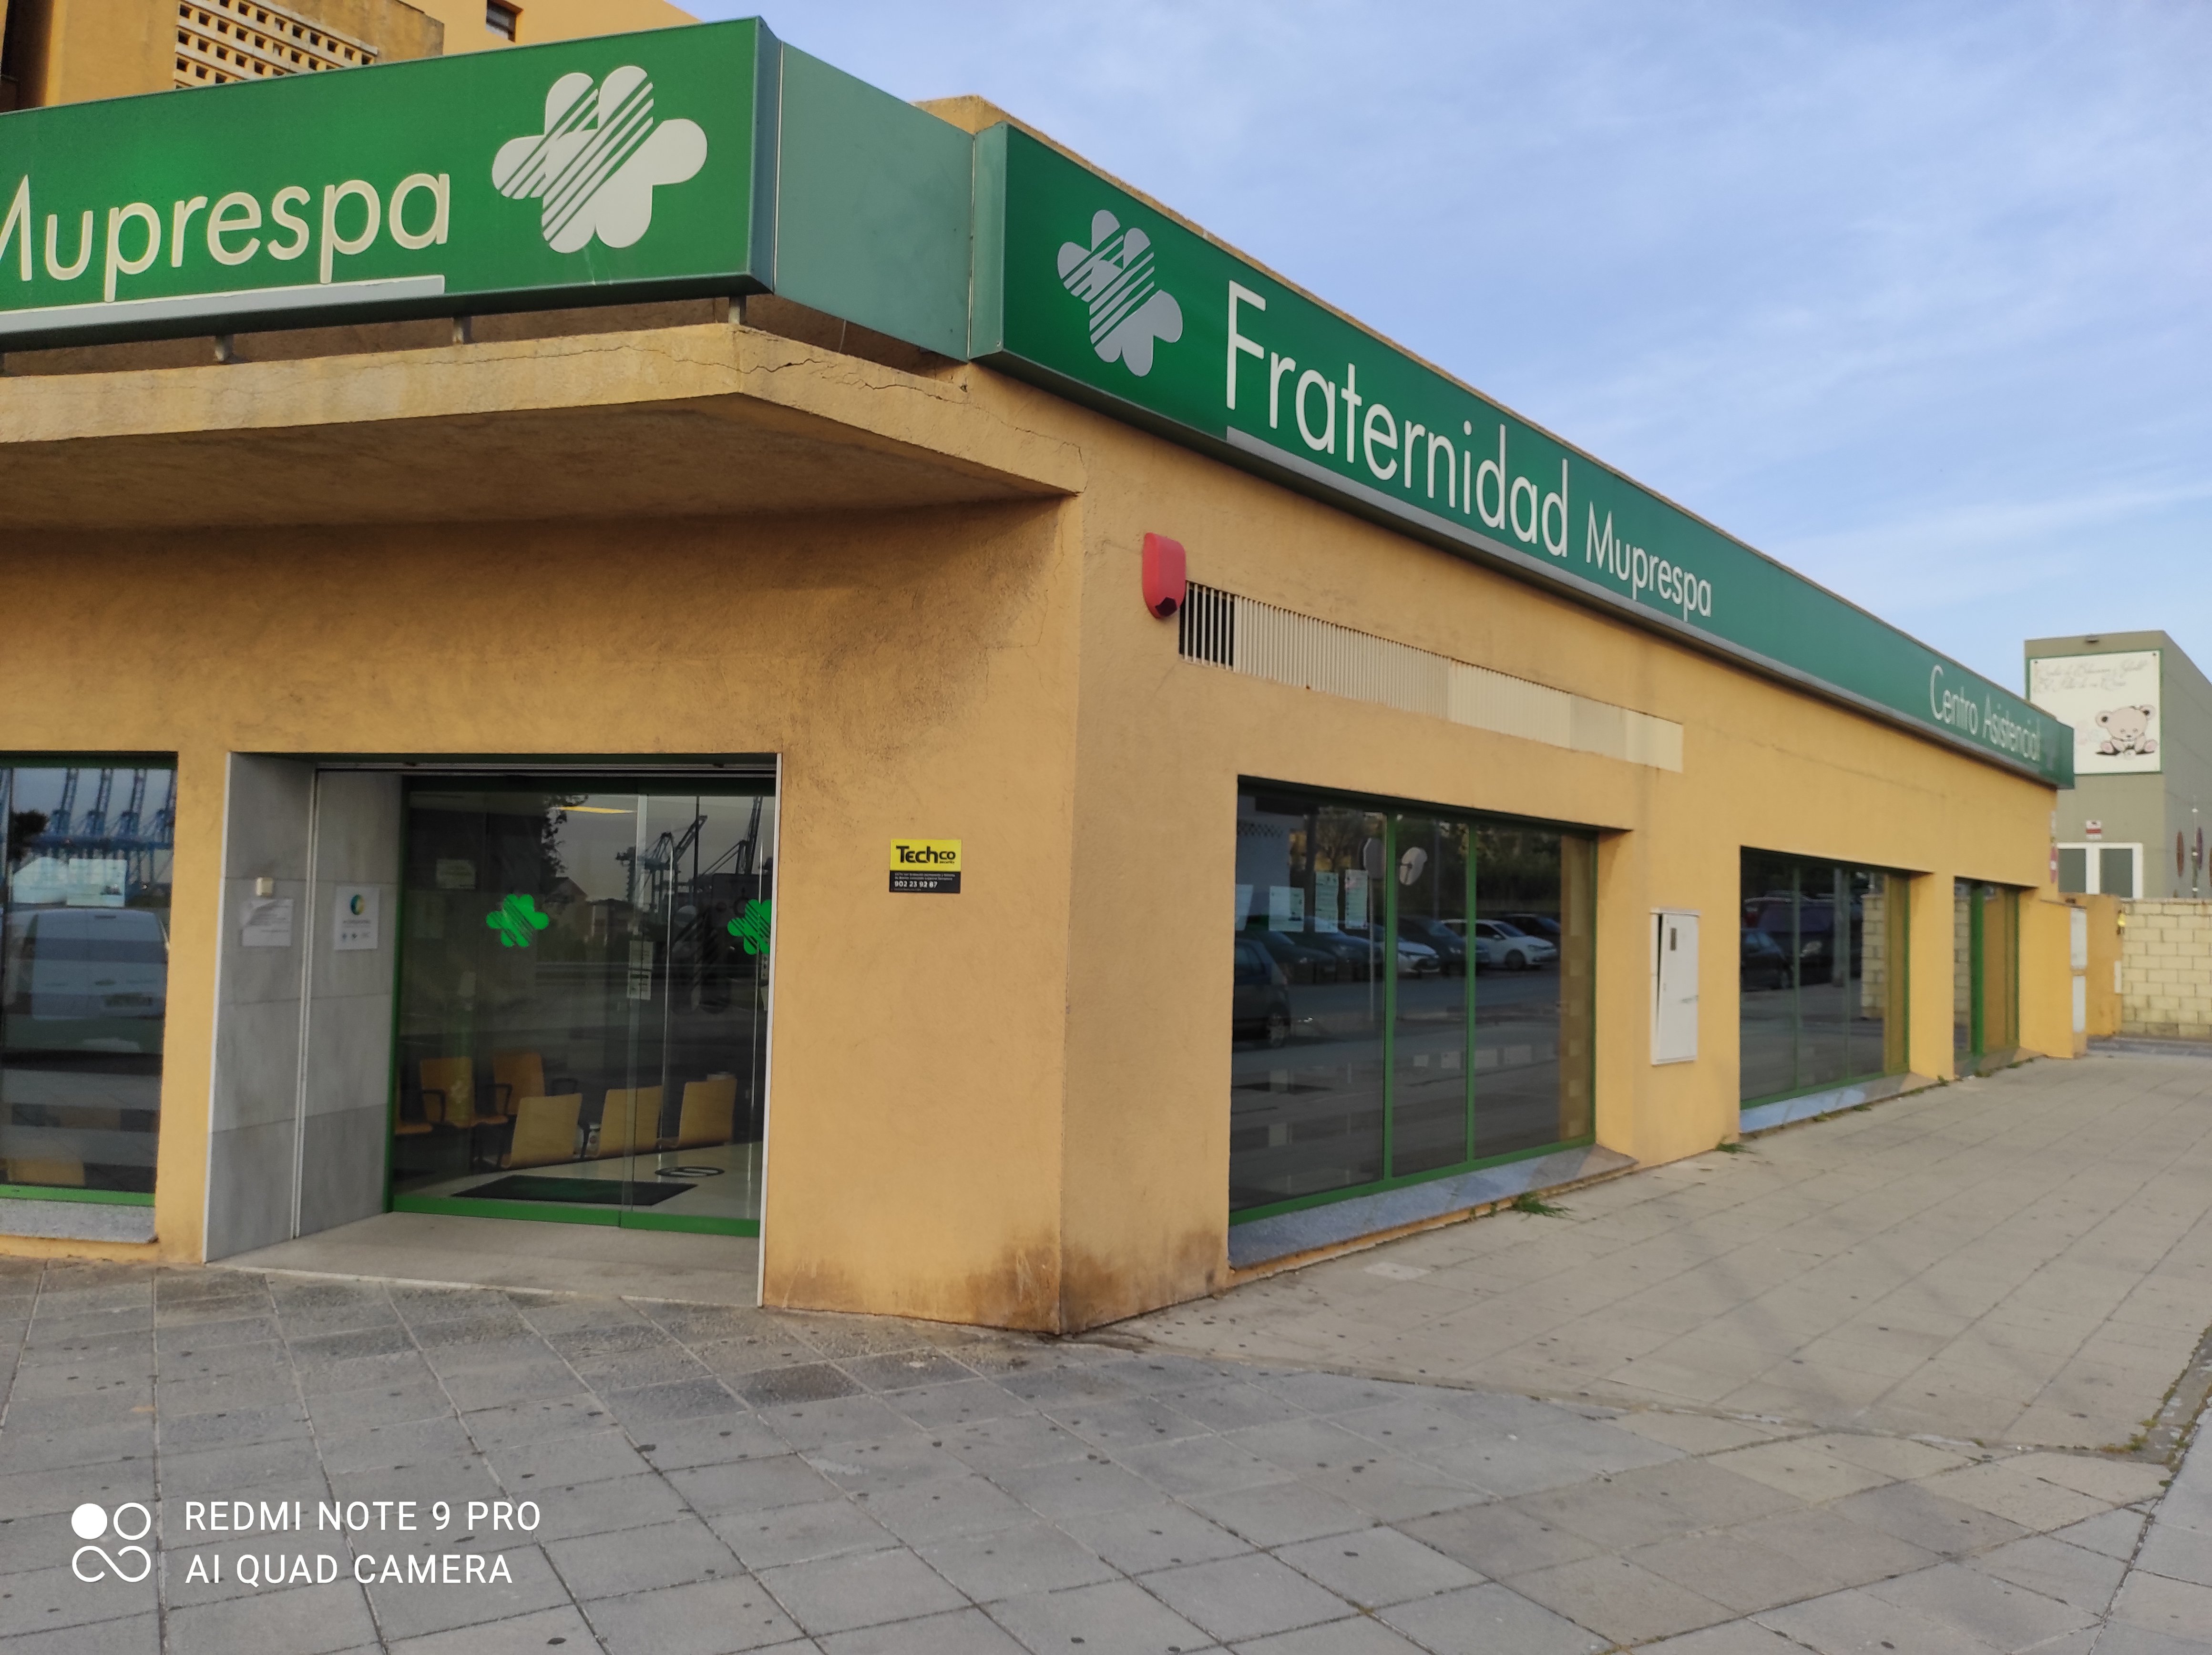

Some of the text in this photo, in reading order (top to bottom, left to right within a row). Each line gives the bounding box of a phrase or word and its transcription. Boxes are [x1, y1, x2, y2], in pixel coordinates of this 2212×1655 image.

[1226, 280, 1711, 622] Fraternidad Muprespa
[1930, 665, 1978, 736] Centro
